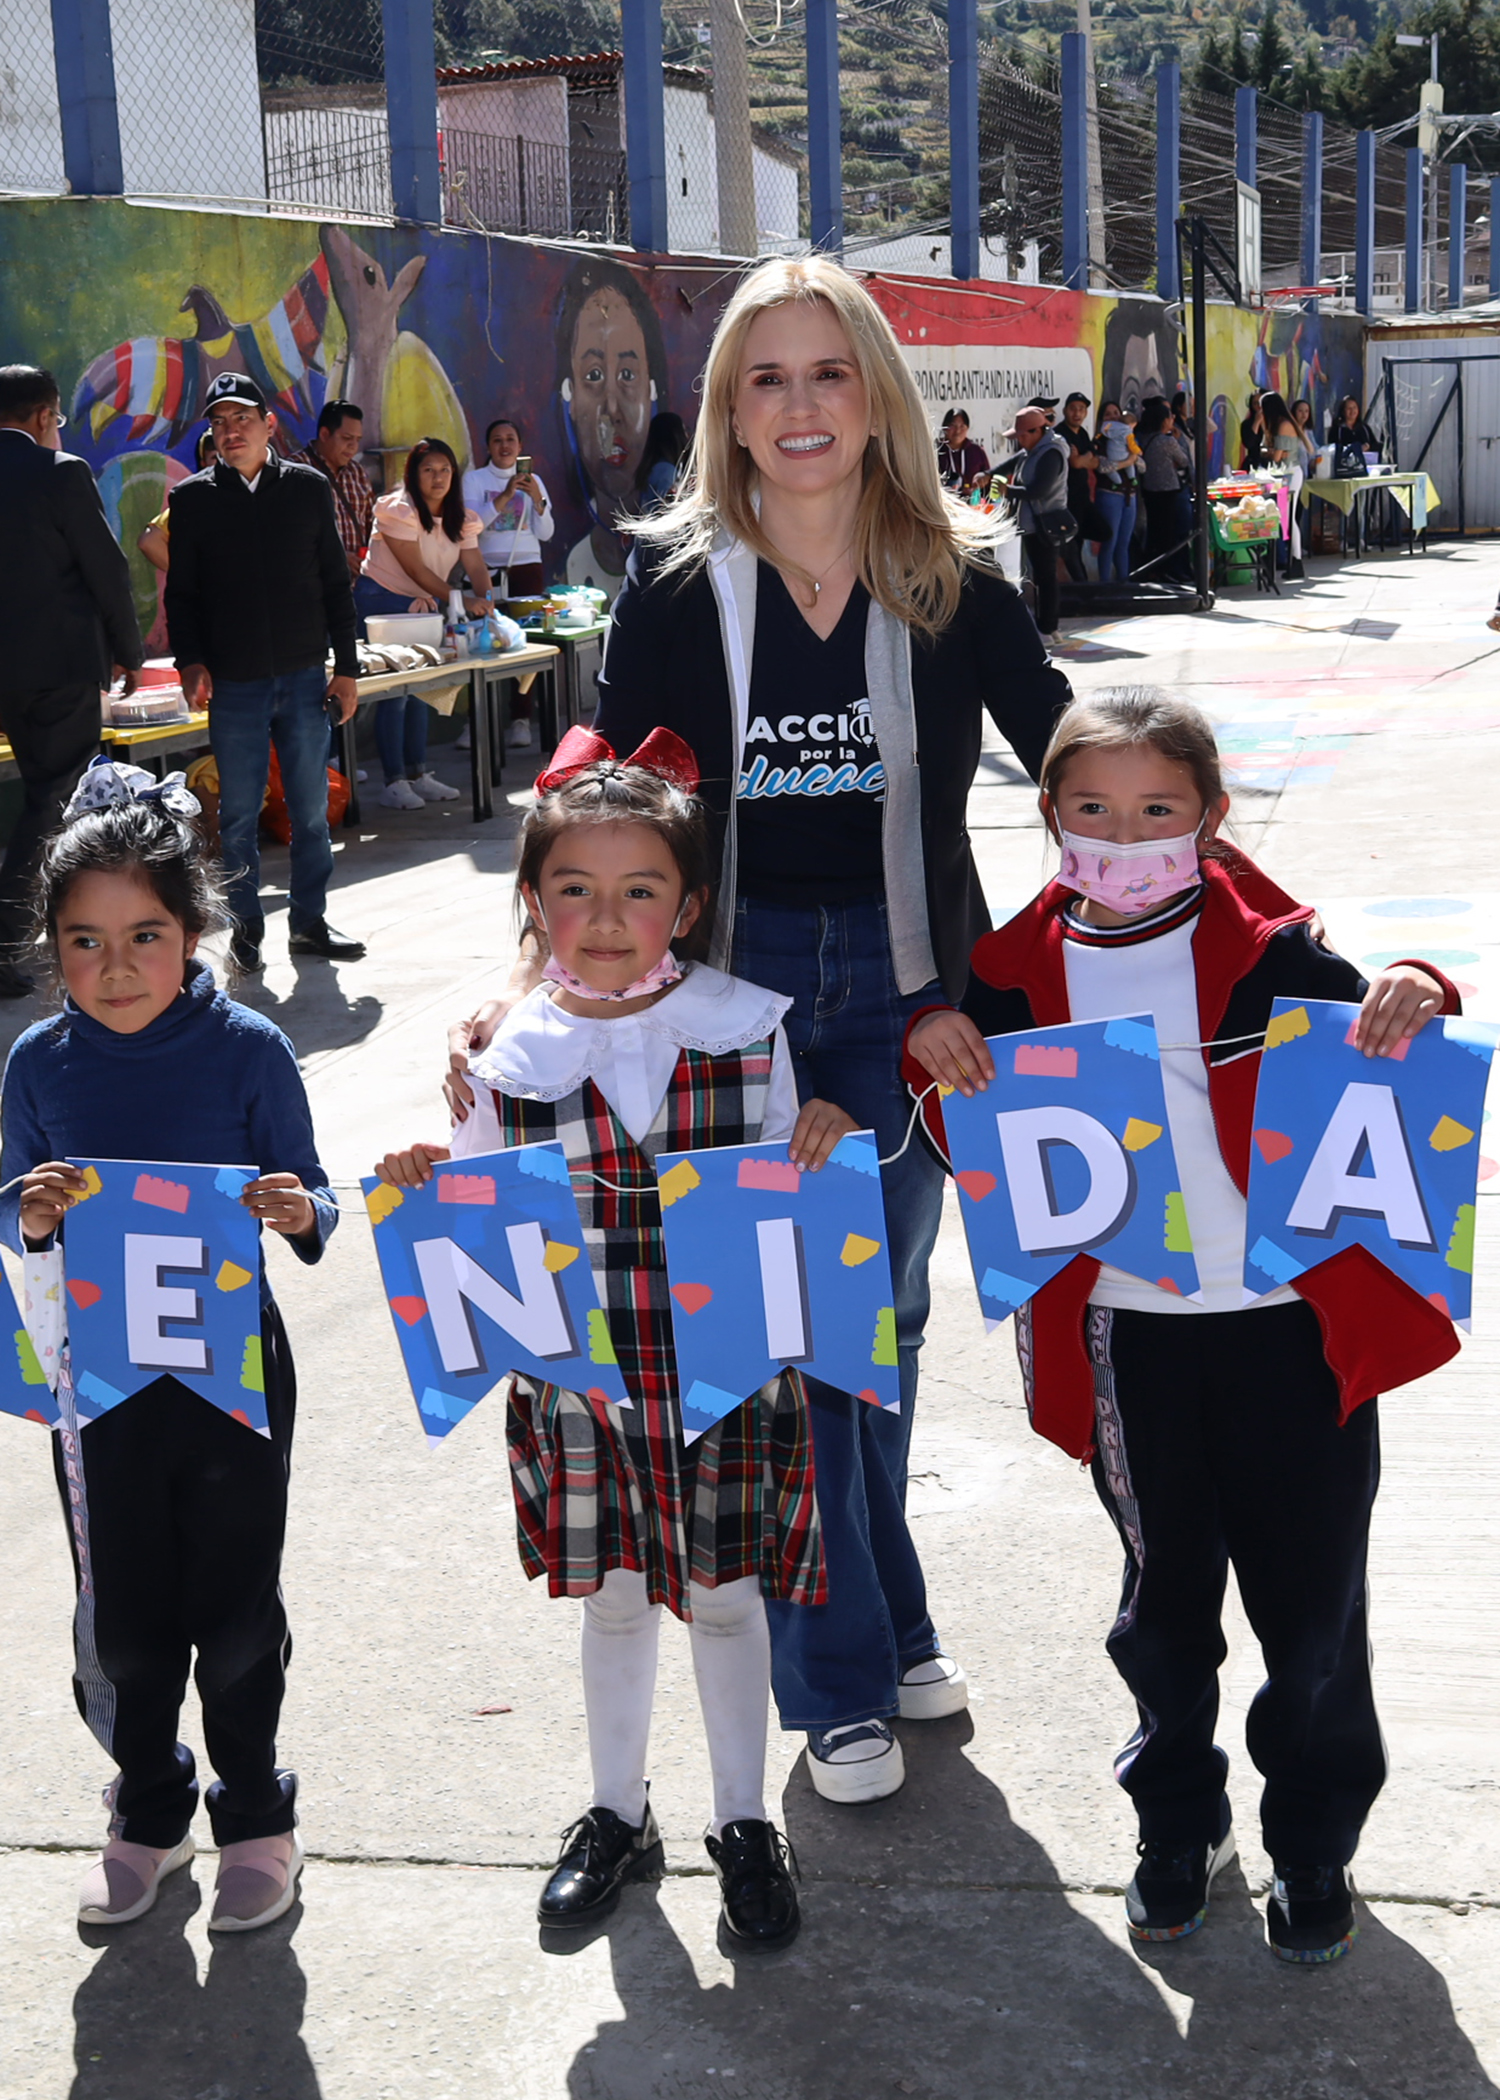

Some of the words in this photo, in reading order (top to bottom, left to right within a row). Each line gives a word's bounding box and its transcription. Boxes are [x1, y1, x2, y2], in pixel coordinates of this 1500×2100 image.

[799, 750, 833, 762] por
[839, 747, 857, 760] la
[124, 1233, 213, 1374] E
[412, 1221, 579, 1376] N
[756, 1217, 814, 1365] I
[996, 1106, 1137, 1257] D
[1286, 1082, 1438, 1252] A
